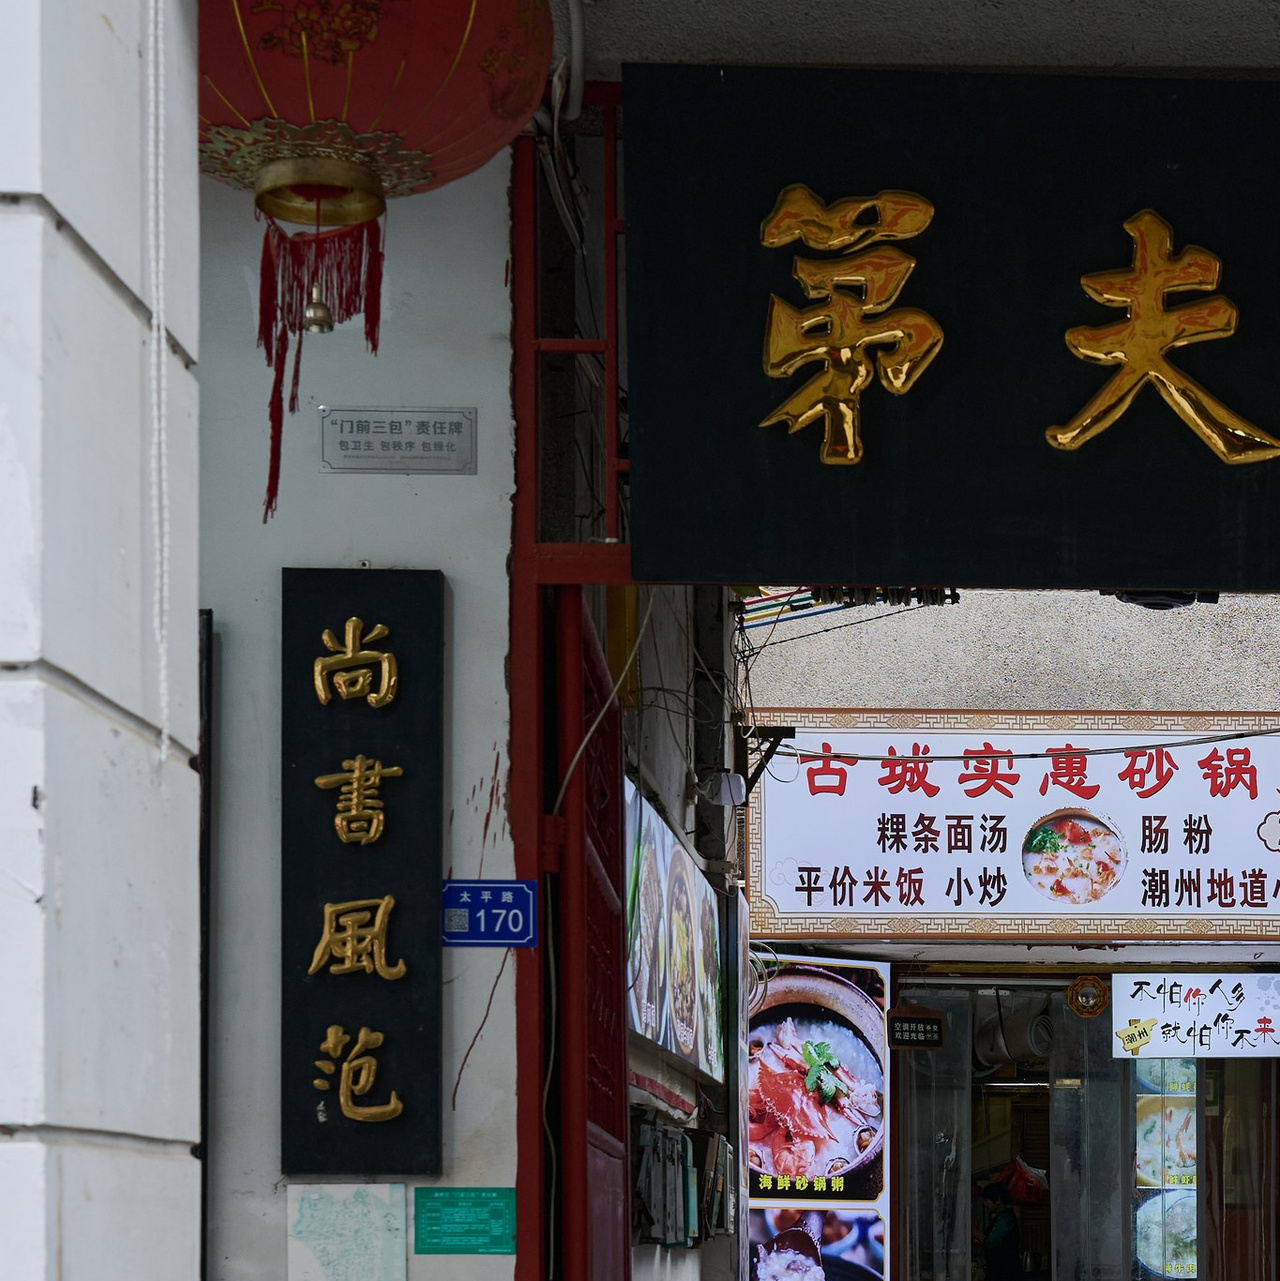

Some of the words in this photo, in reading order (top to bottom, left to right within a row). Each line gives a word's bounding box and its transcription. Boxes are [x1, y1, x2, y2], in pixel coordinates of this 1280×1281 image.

[877, 813, 1008, 855] 粿条面汤
[1141, 814, 1213, 855] 肠粉
[460, 890, 515, 904] 太平路
[795, 866, 924, 907] 平价米饭
[945, 866, 1008, 908] 小炒
[475, 909, 524, 933] 170
[1130, 977, 1246, 1016] 不怕你人多
[1160, 1012, 1280, 1056] 就怕你不来
[758, 1174, 845, 1193] 海鲜砂锅粥
